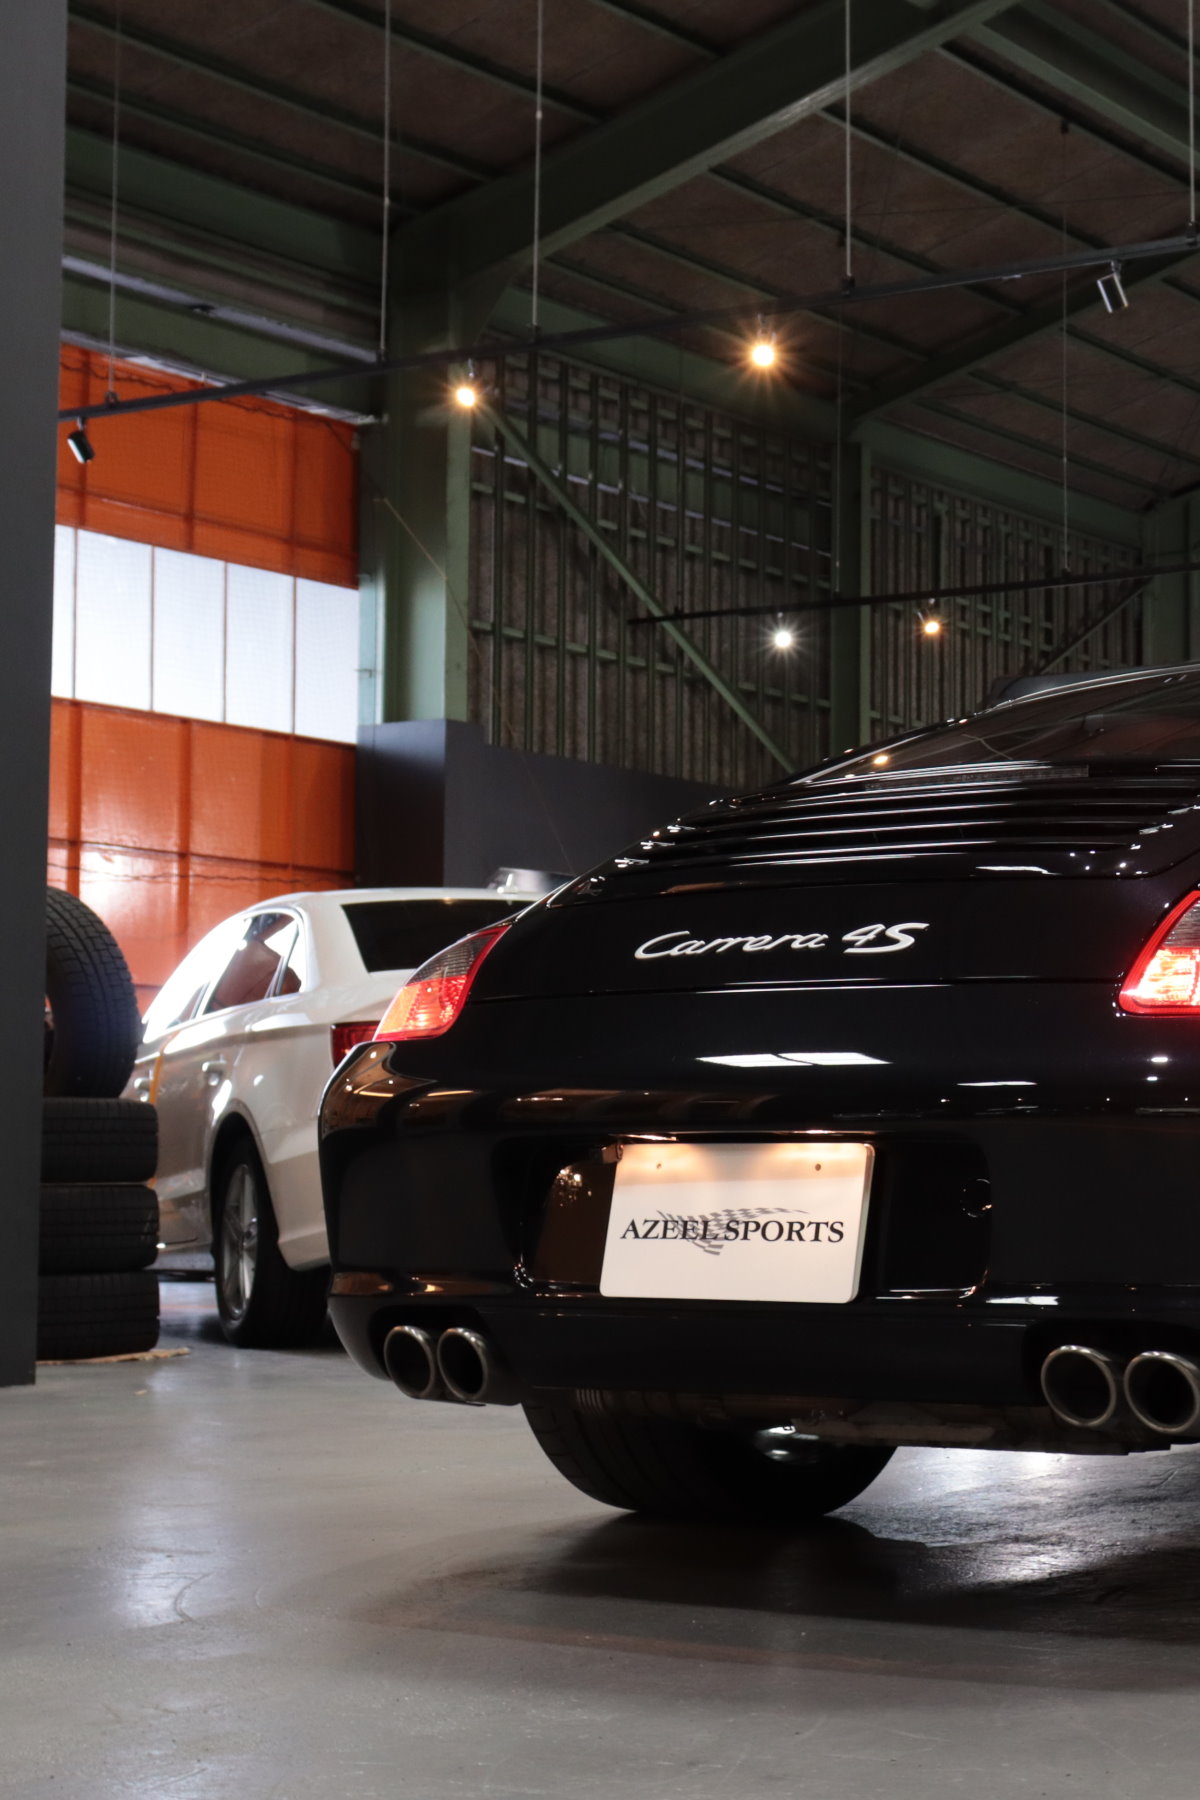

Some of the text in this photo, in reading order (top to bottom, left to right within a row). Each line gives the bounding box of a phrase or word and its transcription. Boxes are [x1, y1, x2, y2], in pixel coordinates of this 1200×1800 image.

[634, 922, 930, 959] Carrera 4S
[620, 1219, 844, 1243] AZEEL SPORTS
